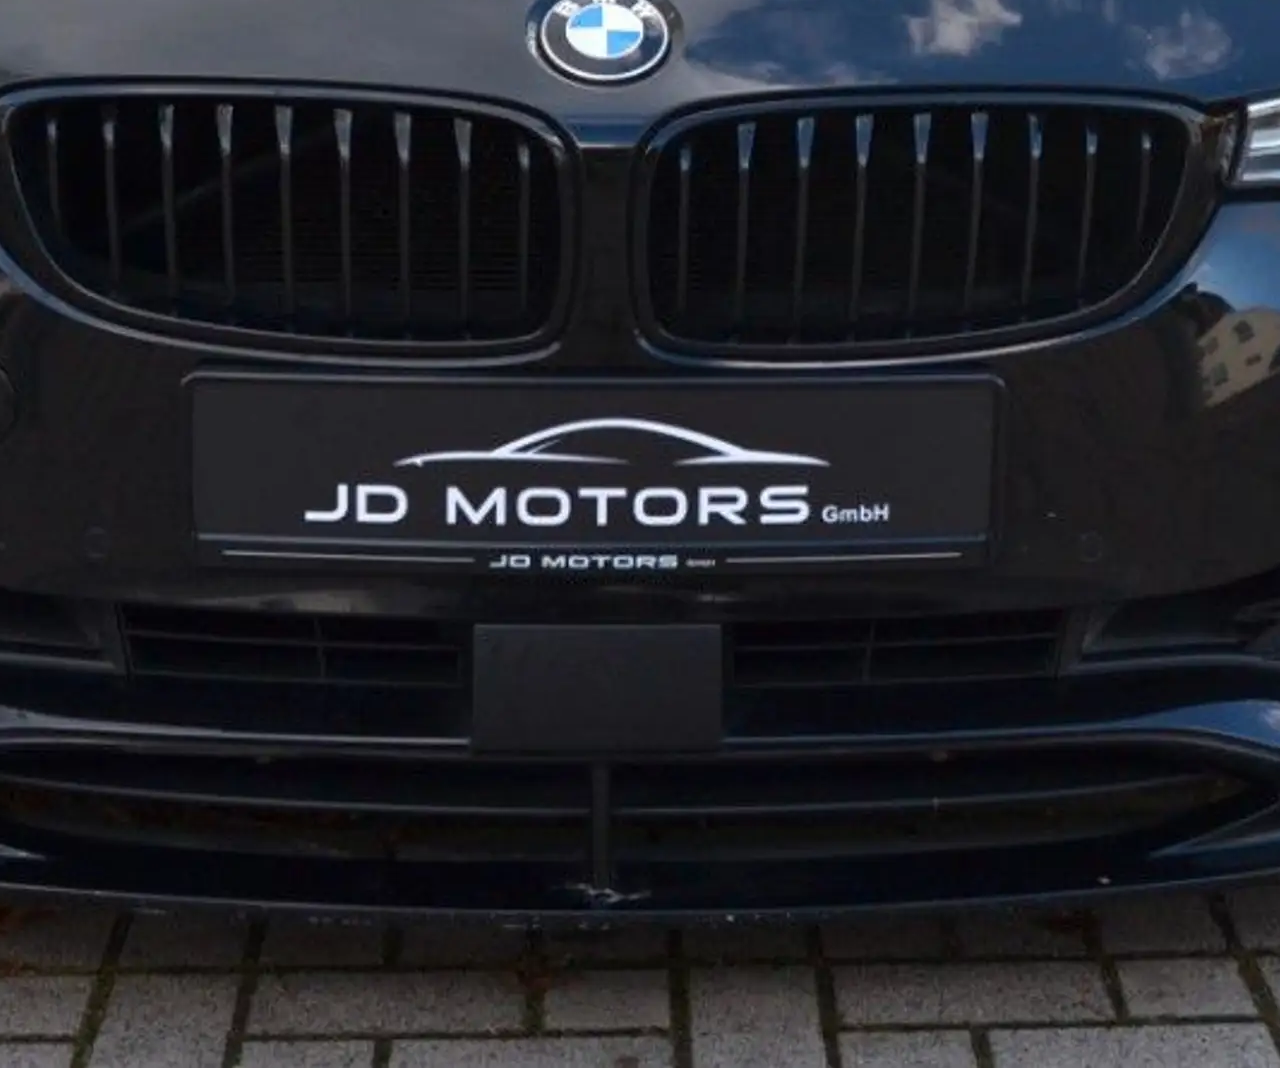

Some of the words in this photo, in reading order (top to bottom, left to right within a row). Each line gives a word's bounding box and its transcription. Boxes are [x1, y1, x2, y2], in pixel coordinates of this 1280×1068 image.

[304, 483, 409, 524] JD
[446, 485, 811, 527] MOTORS
[822, 503, 890, 524] GmbH
[489, 555, 532, 569] JD
[541, 554, 678, 569] MOTORS
